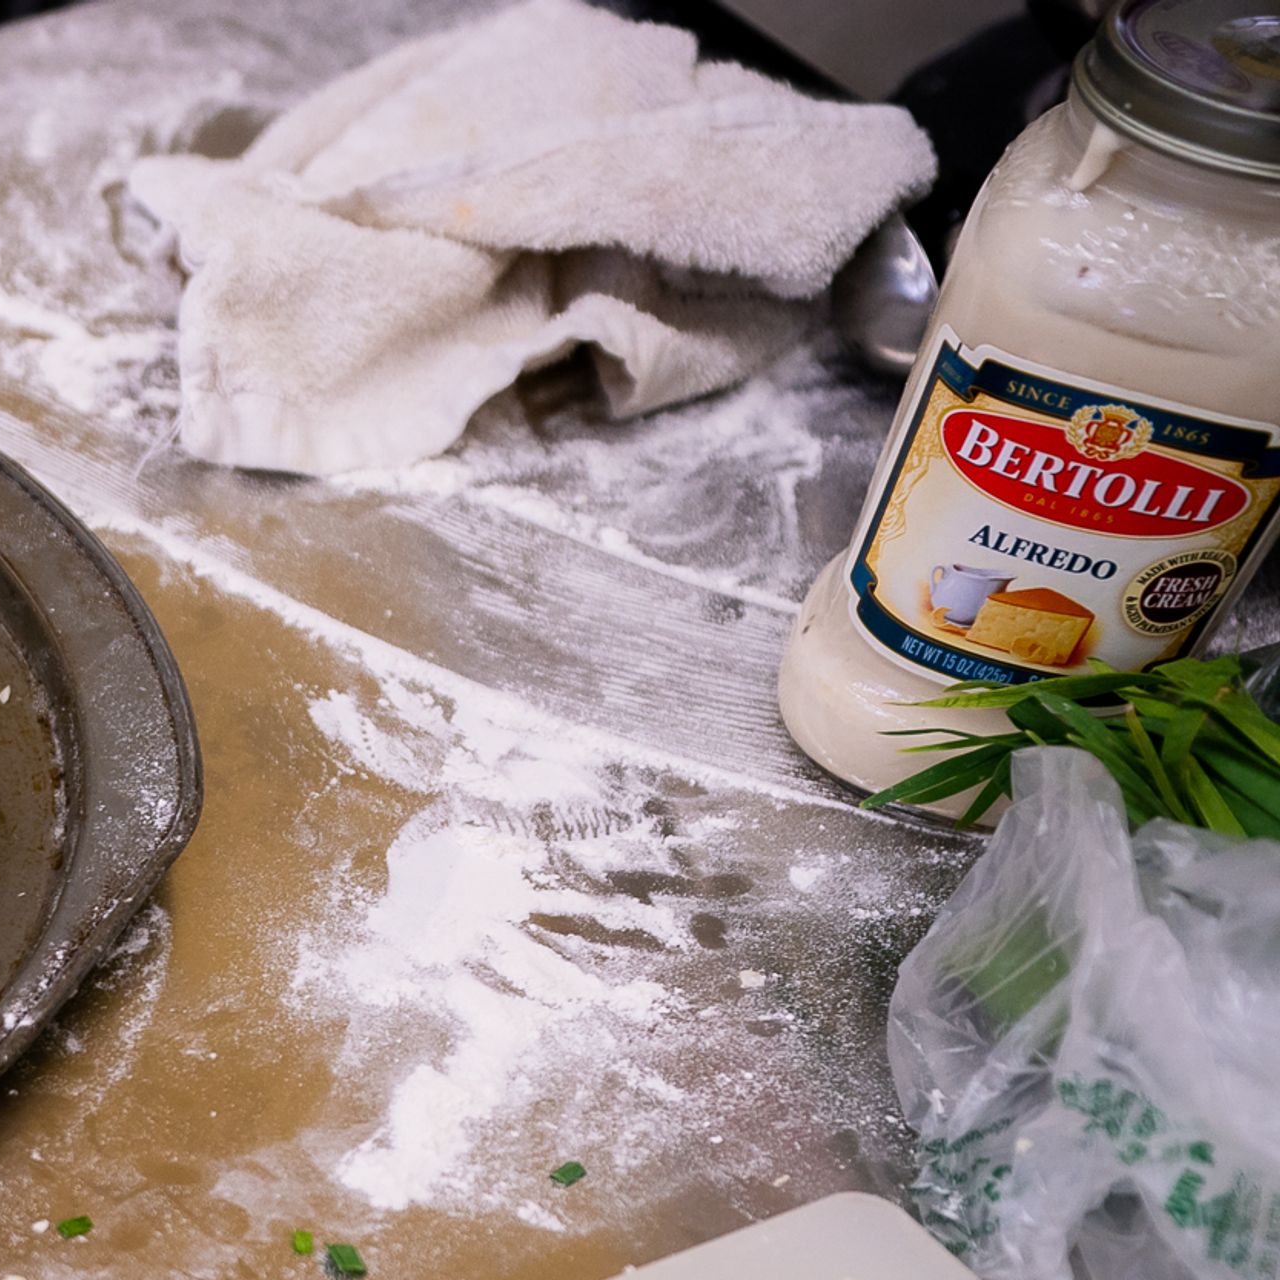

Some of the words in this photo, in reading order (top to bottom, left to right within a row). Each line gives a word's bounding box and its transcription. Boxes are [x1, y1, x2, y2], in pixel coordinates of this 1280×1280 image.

[1006, 379, 1073, 410] SINCE
[1162, 424, 1211, 445] 1865
[955, 418, 1227, 523] BERTOLLI
[1023, 493, 1057, 510] DAL
[1069, 508, 1115, 524] 1865
[968, 524, 1118, 580] ALFREDO
[1136, 562, 1168, 585] MADE
[1167, 552, 1199, 566] WITH
[1142, 591, 1213, 609] CREAM
[1152, 574, 1220, 593] FRESH
[901, 634, 925, 658] NET
[924, 641, 942, 668] WT
[941, 652, 956, 670] 15
[956, 656, 975, 677] OZ
[973, 662, 1015, 685] (425g)
